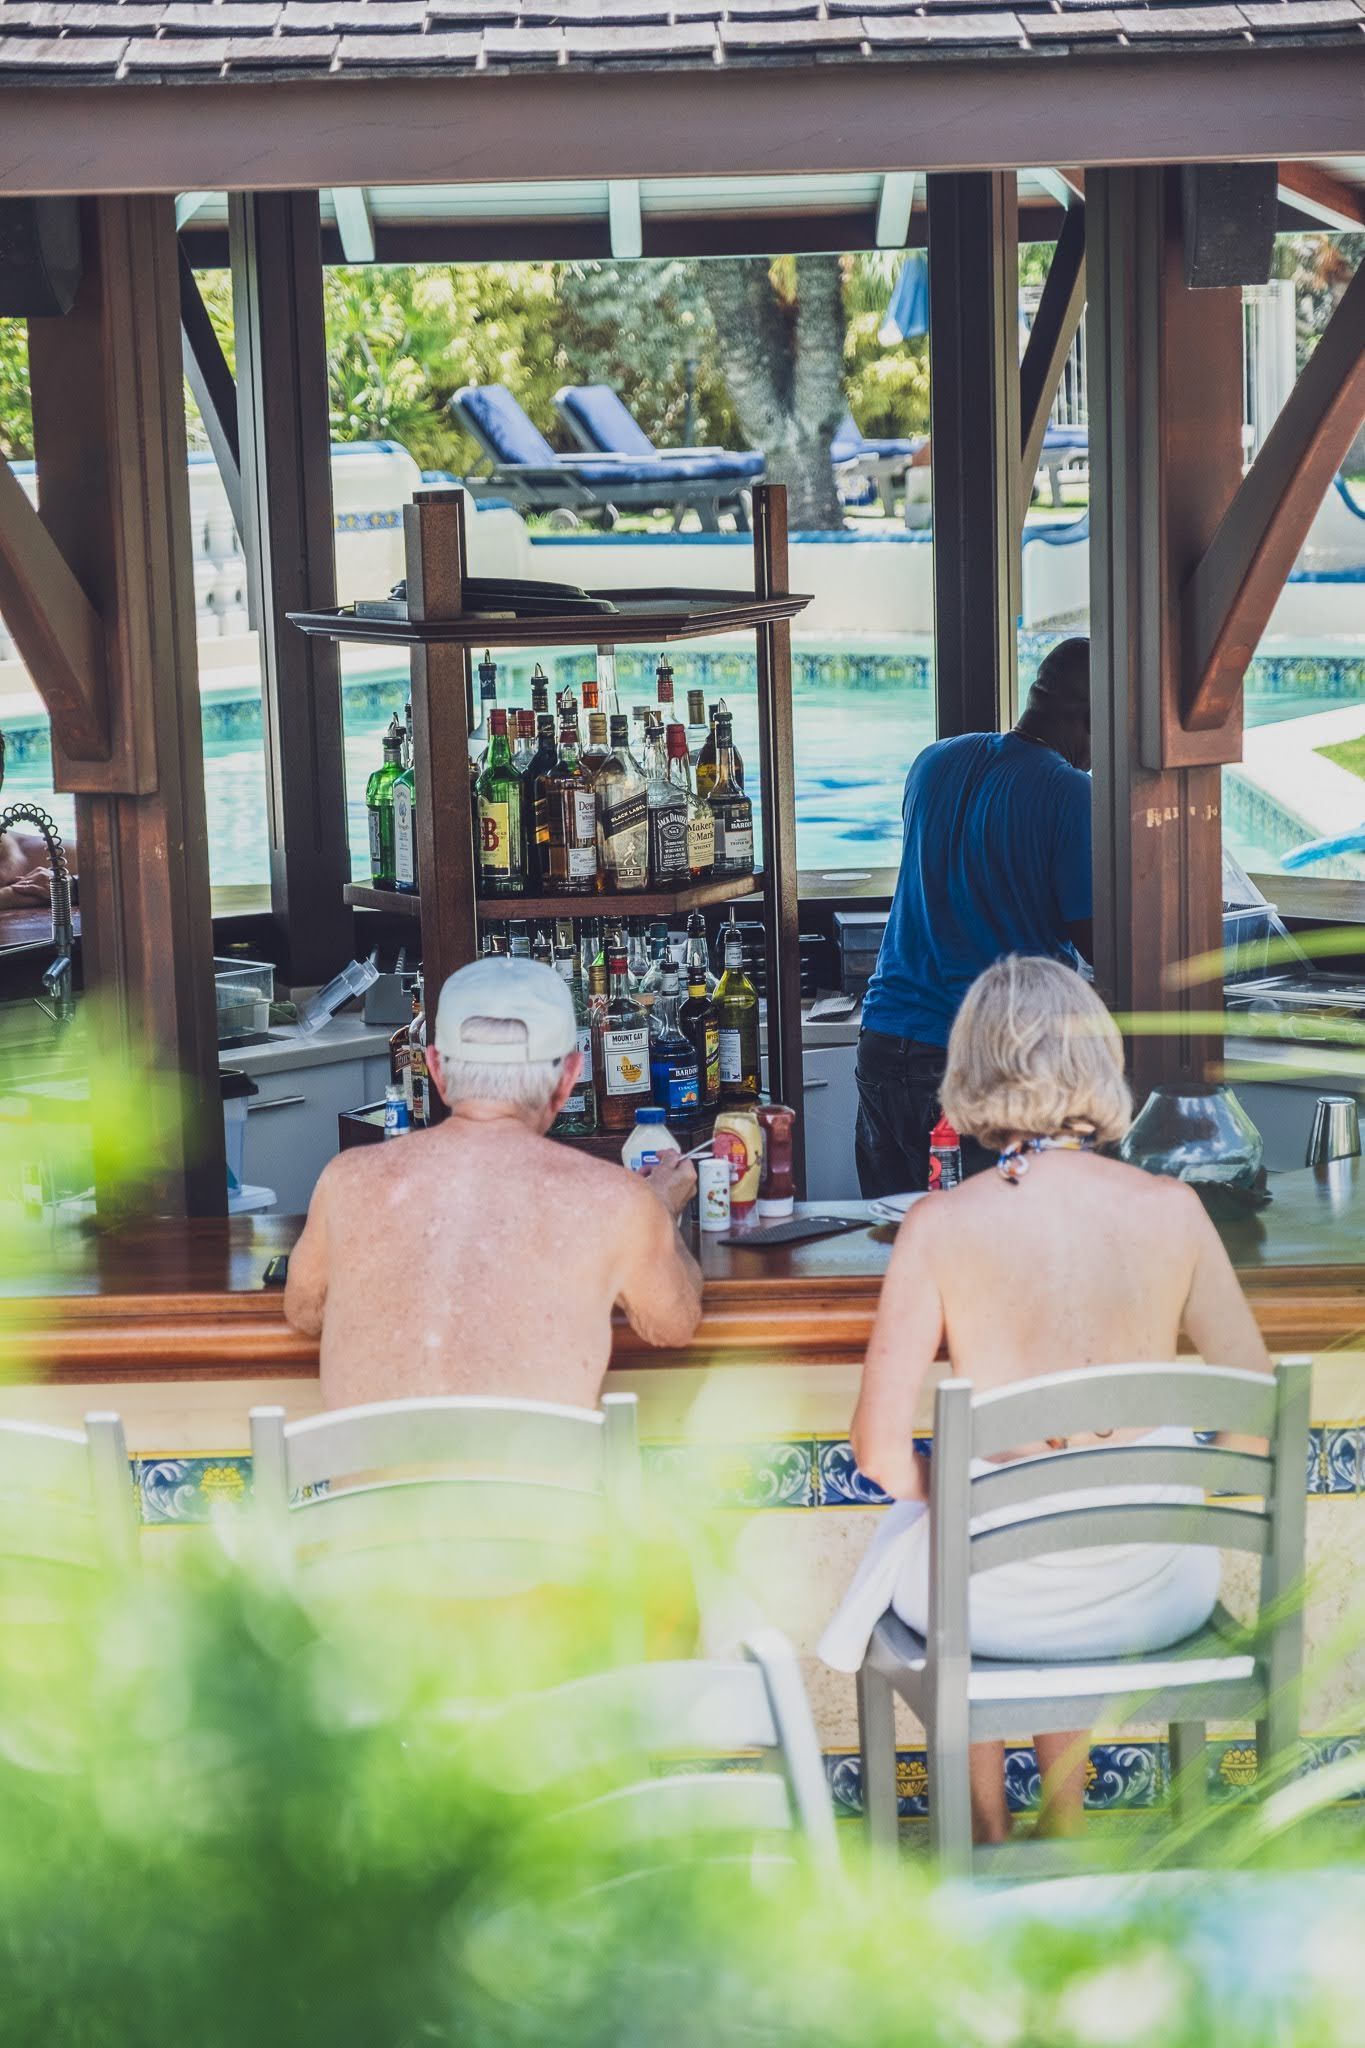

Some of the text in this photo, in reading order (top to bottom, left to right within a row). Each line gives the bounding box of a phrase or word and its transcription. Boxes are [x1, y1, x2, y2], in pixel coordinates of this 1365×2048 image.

[610, 811, 629, 823] BLACK
[628, 804, 647, 815] LABEL
[657, 815, 671, 829] JACK
[688, 821, 715, 832] Maker's
[612, 1032, 644, 1042] MOUNT GAY
[616, 1062, 644, 1072] ECLIPSE
